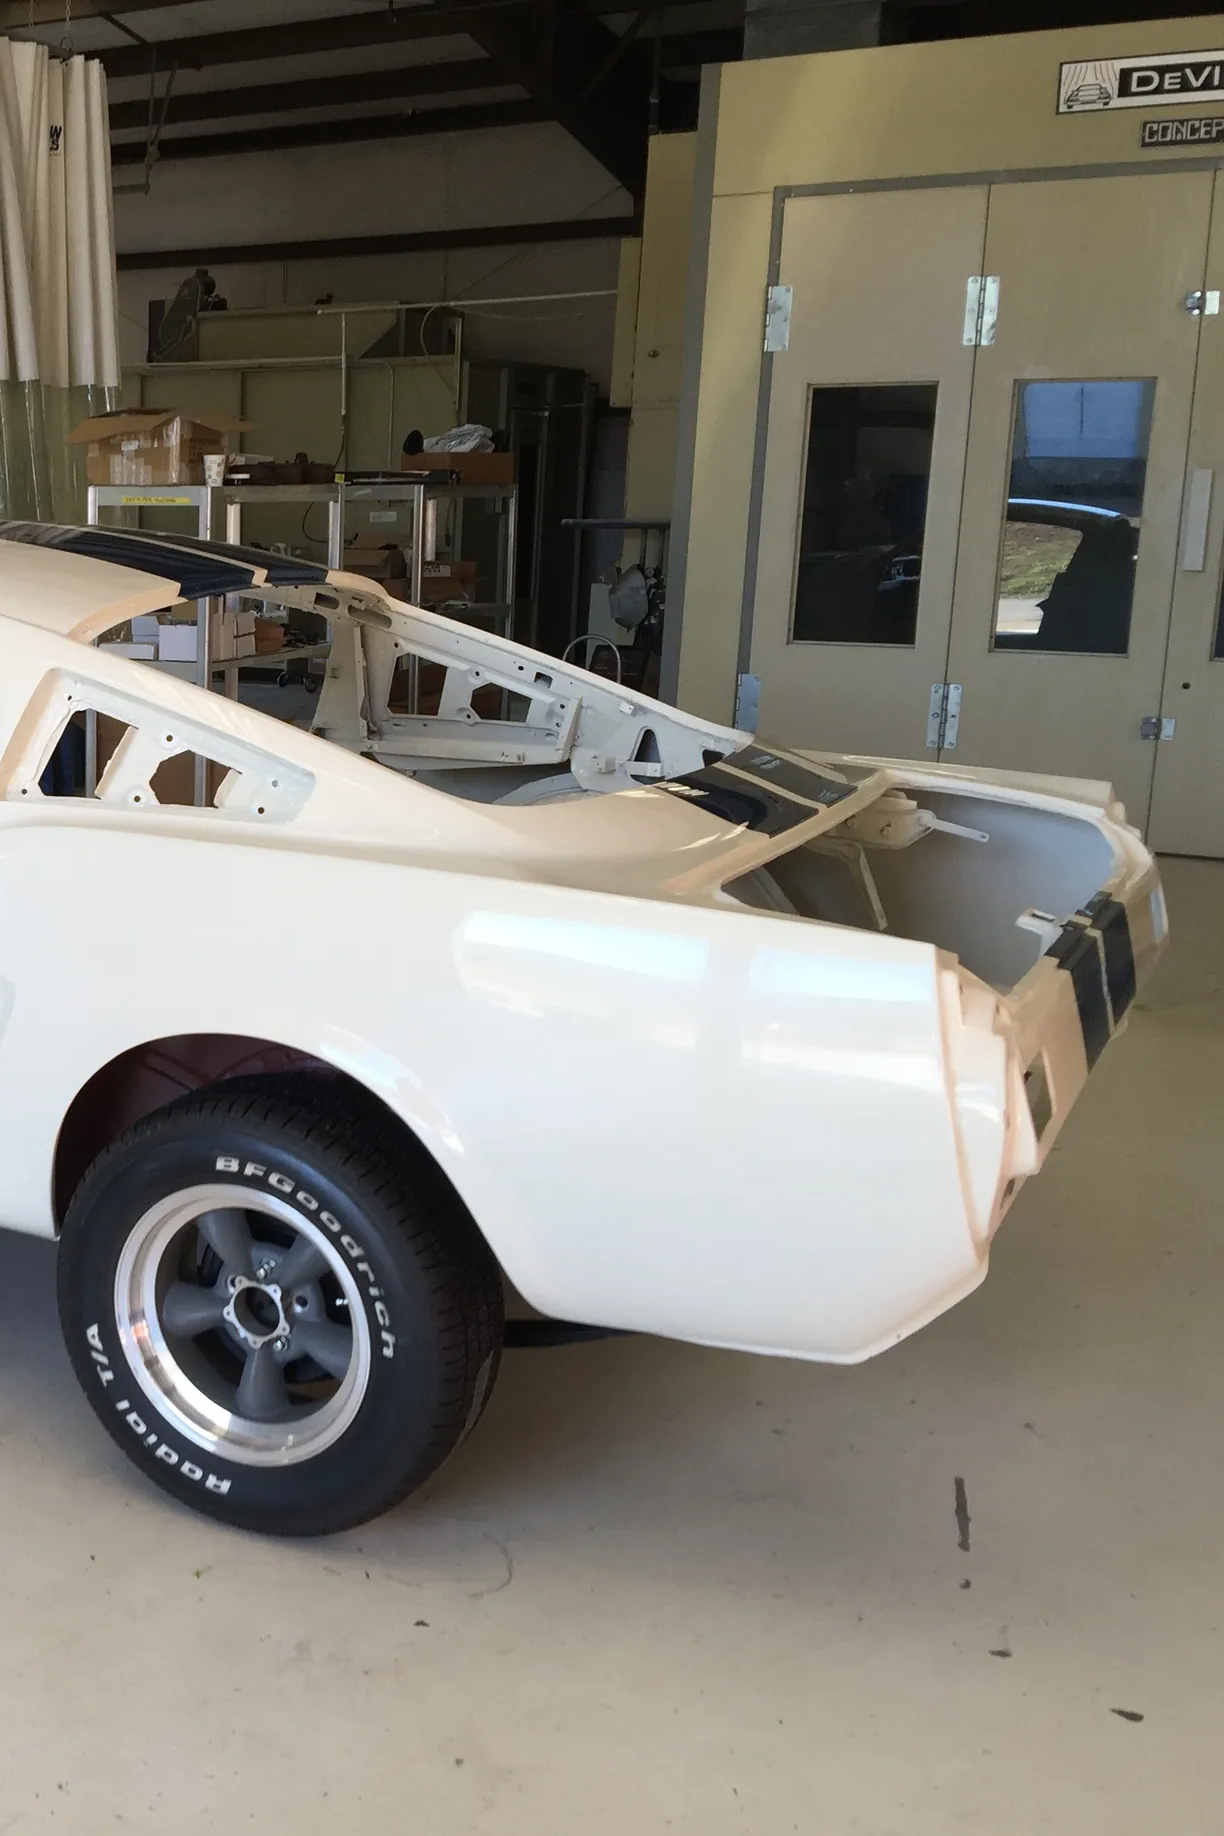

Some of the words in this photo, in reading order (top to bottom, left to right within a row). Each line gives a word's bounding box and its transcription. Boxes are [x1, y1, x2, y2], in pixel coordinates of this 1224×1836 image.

[215, 1155, 396, 1359] BFGoodrich
[86, 1322, 115, 1388] T/A
[115, 1398, 232, 1496] Radial
